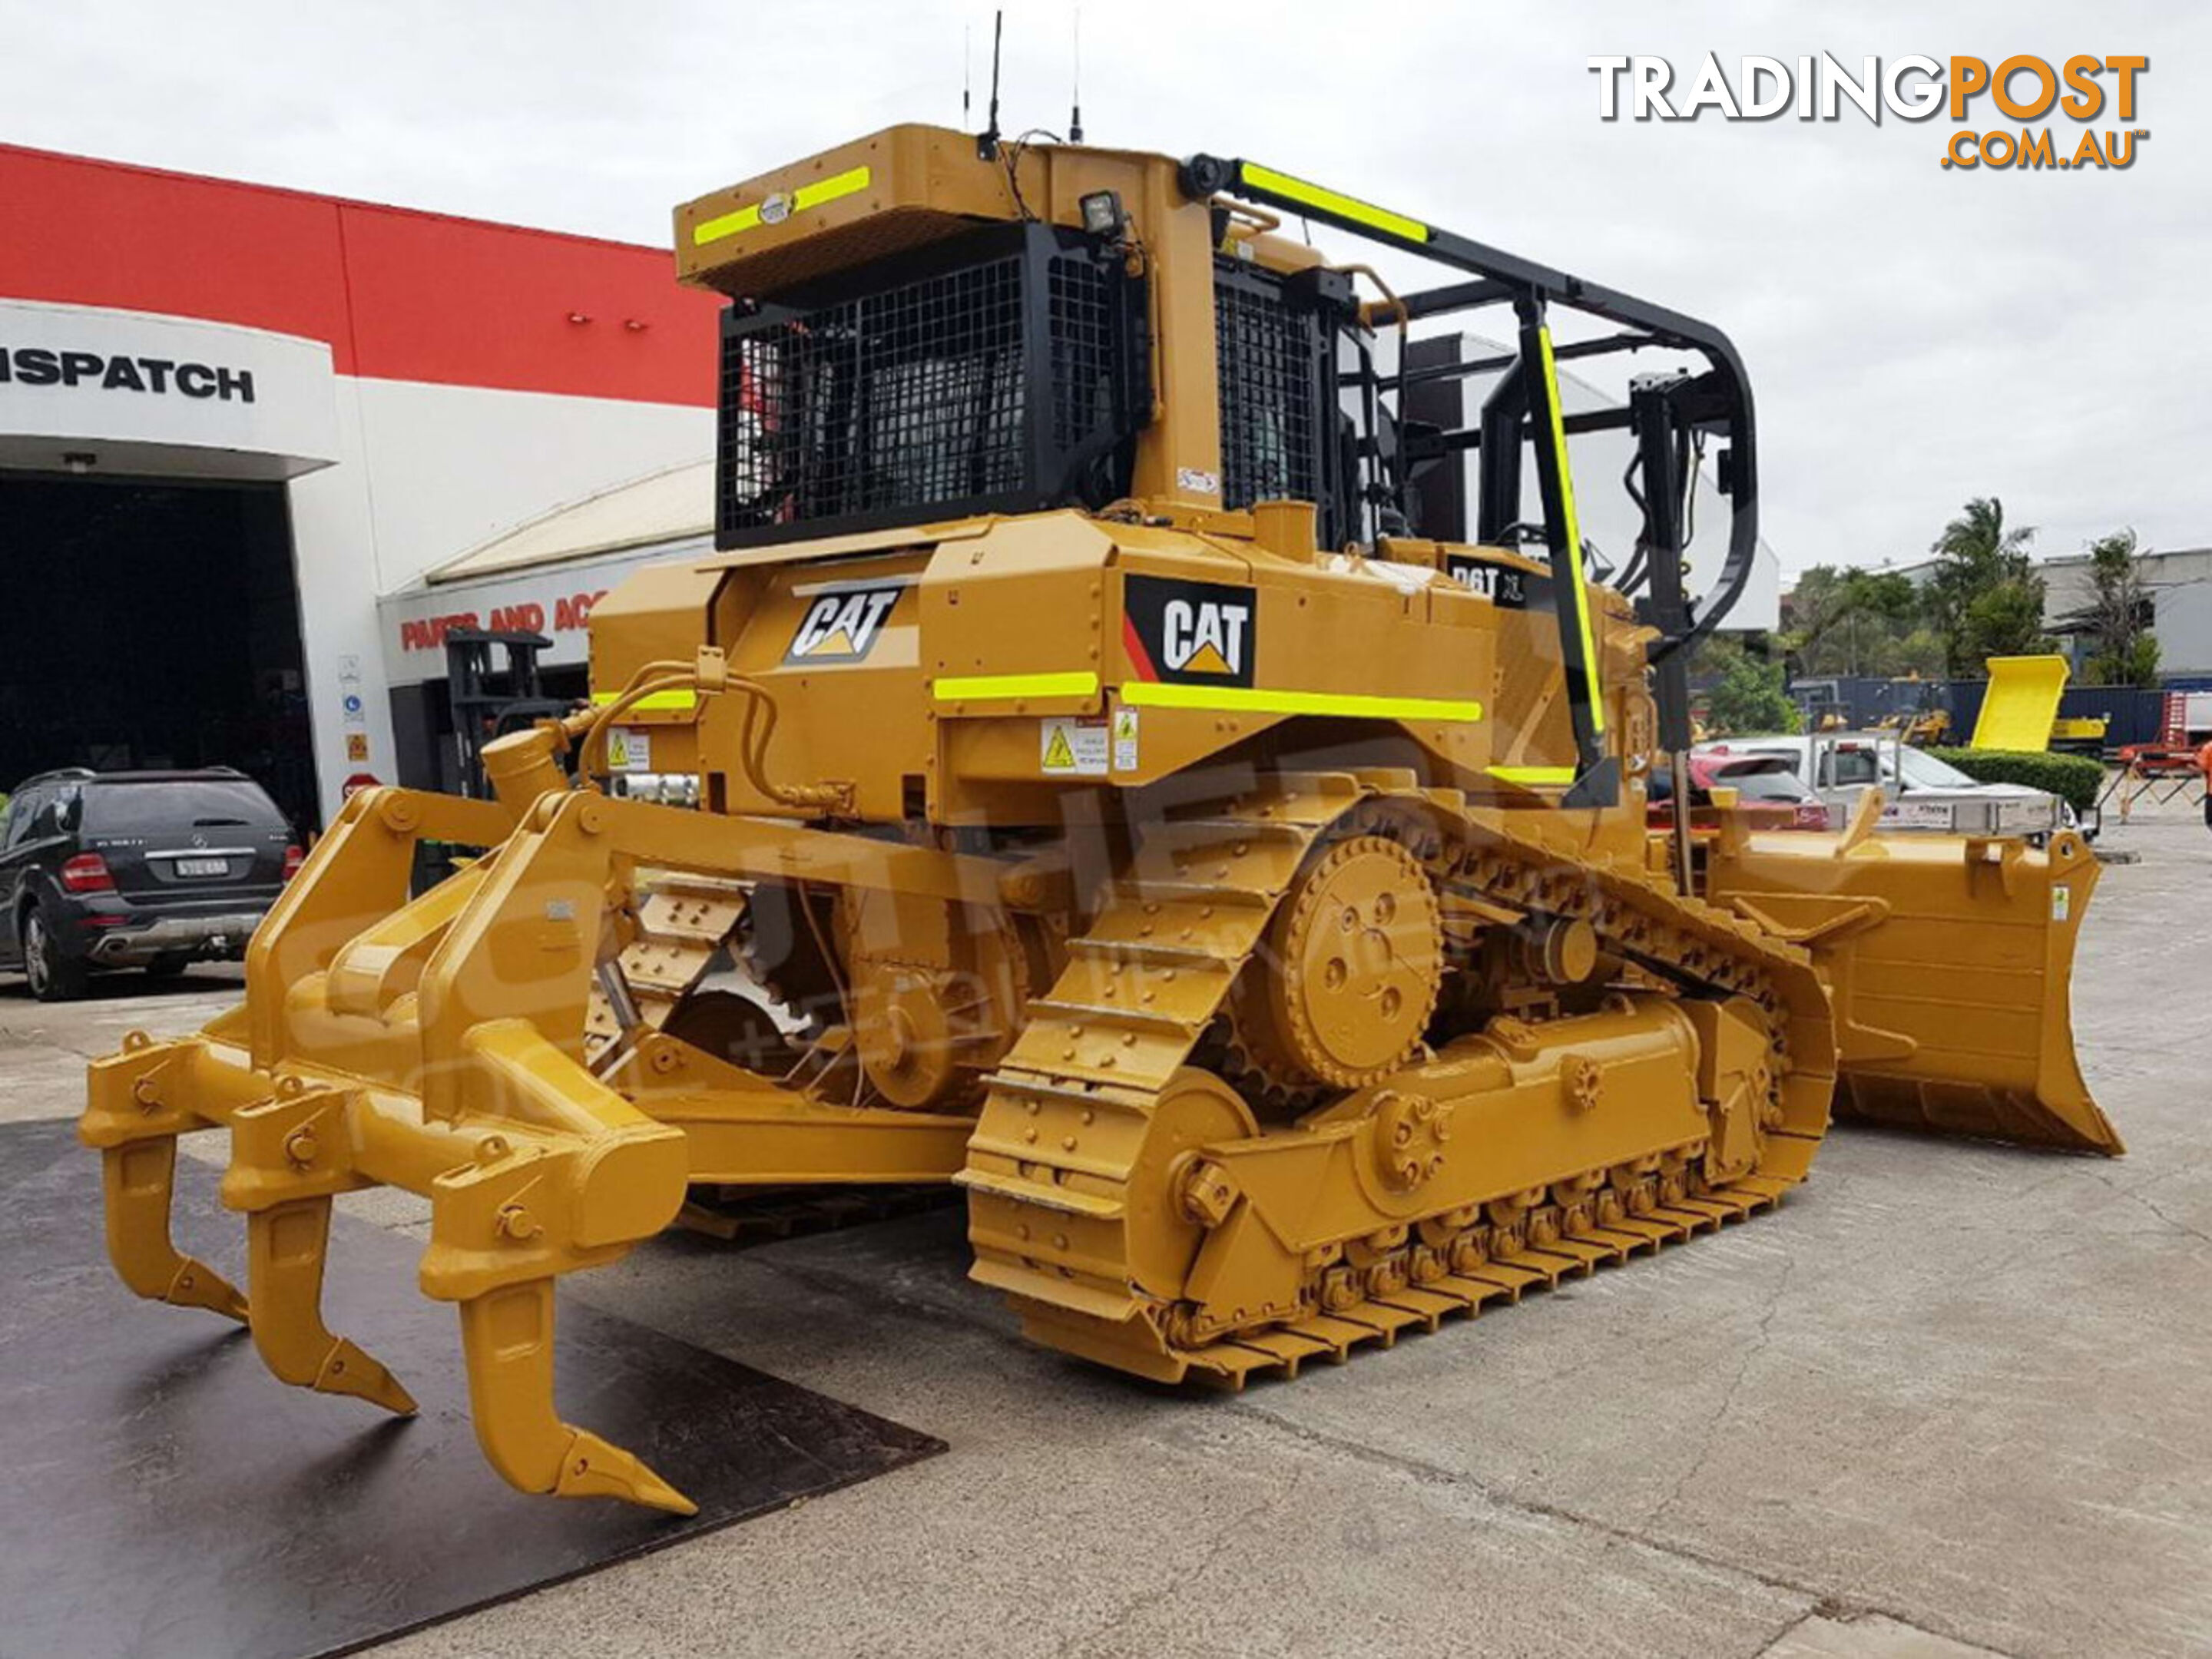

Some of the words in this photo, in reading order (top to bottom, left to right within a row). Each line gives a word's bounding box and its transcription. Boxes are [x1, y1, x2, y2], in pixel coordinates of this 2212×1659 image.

[490, 603, 544, 633] AND
[792, 591, 899, 657] CAT
[1163, 599, 1248, 674] CAT
